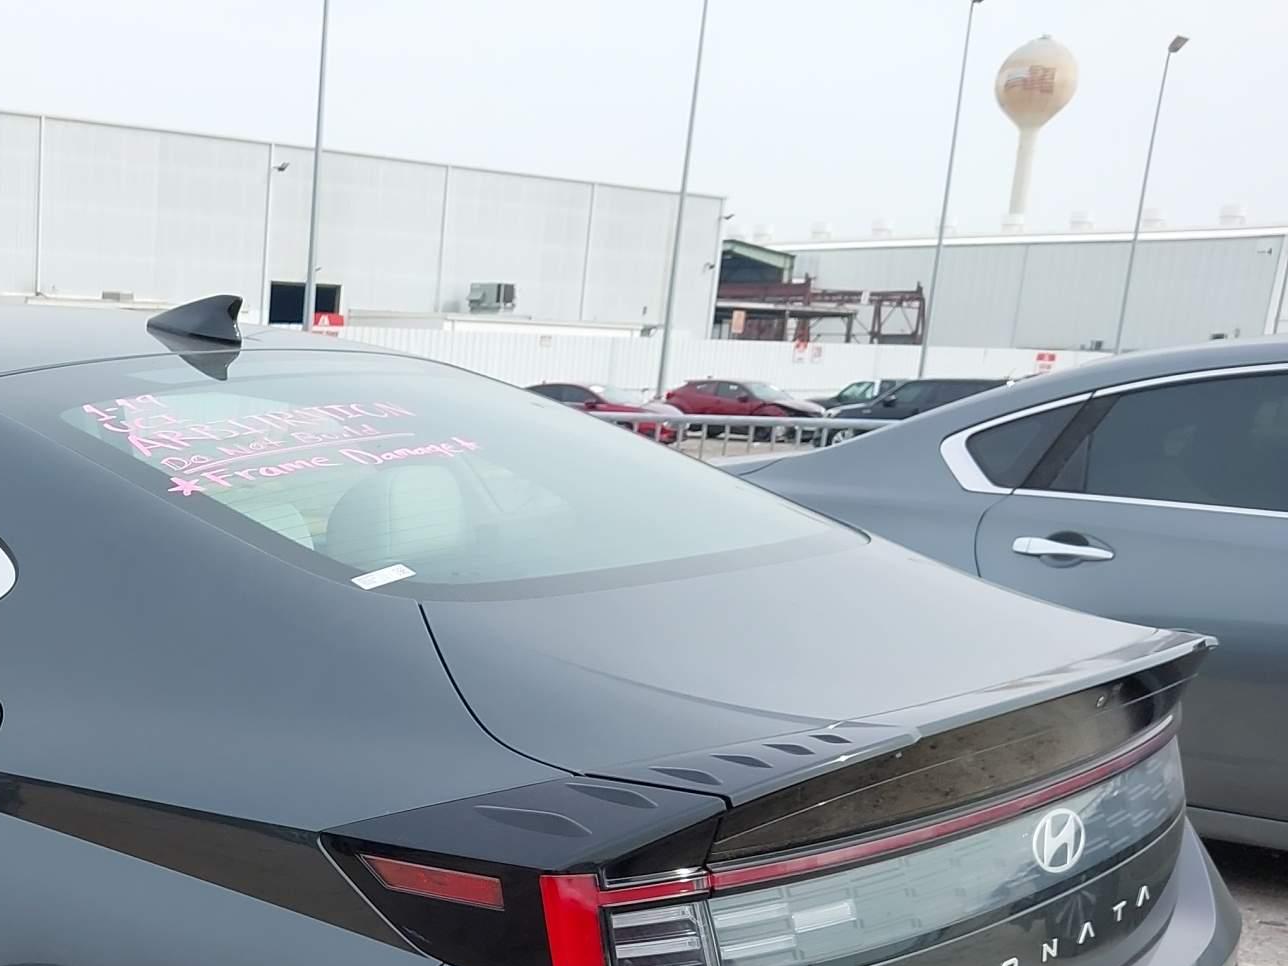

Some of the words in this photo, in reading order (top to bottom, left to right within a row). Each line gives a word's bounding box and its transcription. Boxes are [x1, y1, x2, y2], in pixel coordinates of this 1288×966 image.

[160, 455, 210, 471] Do
[216, 437, 287, 456] Not
[200, 456, 344, 487] Frame
[338, 442, 464, 466] Damage
